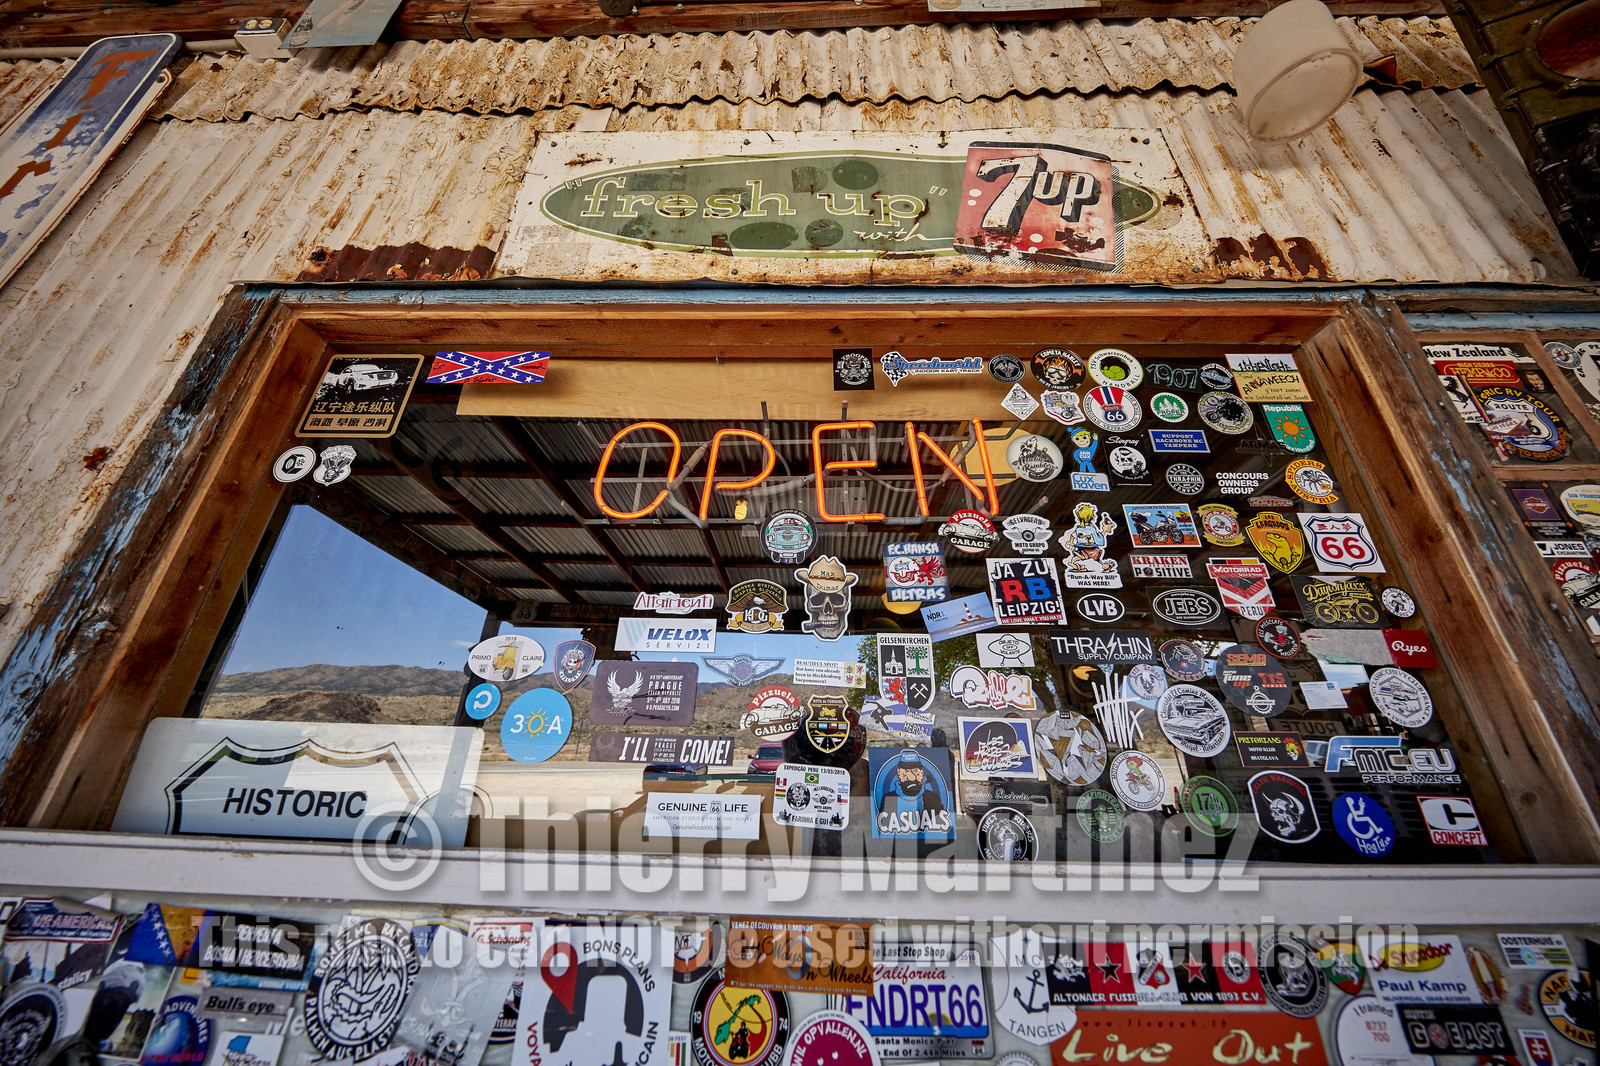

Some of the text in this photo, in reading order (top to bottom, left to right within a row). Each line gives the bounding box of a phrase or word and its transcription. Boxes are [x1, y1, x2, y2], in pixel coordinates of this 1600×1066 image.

[1424, 346, 1508, 358] New Zealand
[885, 358, 982, 371] Speedworld
[1102, 374, 1141, 391] HANDBALL
[1146, 363, 1199, 389] 1907
[313, 401, 396, 413] 辽宁途乐纵队
[1263, 404, 1303, 412] Republik
[1107, 412, 1125, 421] 66
[1105, 436, 1140, 446] Stingray
[594, 416, 999, 523] OPEN
[1216, 472, 1269, 480] CONCOURS
[1286, 459, 1323, 482] SPIDERS
[1073, 482, 1109, 490] haven
[1291, 482, 1337, 504] AUSTRIA
[952, 511, 991, 530] Pizzuela
[950, 537, 991, 550] GARAGE
[1320, 537, 1367, 560] 66
[1131, 556, 1188, 565] KRAKEN
[991, 558, 1050, 580] JA ZU
[1554, 562, 1590, 581] Pizzuela
[890, 588, 946, 602] ULTRAS
[1000, 577, 1052, 603] RB
[999, 600, 1061, 618] LEIPZIG!
[1083, 599, 1117, 611] LVB
[1164, 598, 1213, 616] JEBS
[1240, 606, 1264, 616] PERU
[1010, 616, 1023, 624] LOVE
[648, 628, 713, 641] VELOX
[880, 637, 930, 645] GELSENKIRCHEN
[1114, 653, 1153, 661] COMPANY
[1226, 654, 1267, 664] SEMA
[648, 681, 683, 690] PRAGUE
[752, 690, 796, 706] Pizzuela
[754, 722, 799, 738] GARAGE
[680, 738, 732, 765] COME!
[784, 764, 807, 772] EXPEDIÇÃO
[1362, 774, 1462, 784] PERFORMANCE
[222, 788, 368, 818] HISTORIC
[658, 802, 750, 812] GENUINE LIFE
[792, 814, 815, 824] FARINHA
[878, 809, 952, 833] CASUALS
[672, 824, 732, 832] GenuineRoute66Life.com
[1432, 832, 1484, 844] CONCEPT
[732, 920, 750, 929] VENEZ
[750, 921, 783, 931] DÉCOUVRIR
[792, 924, 814, 932] MONDE
[882, 946, 945, 958] Last Stop Shop
[583, 940, 656, 992] BONS PLANS
[818, 957, 872, 984] Wheels
[872, 964, 948, 986] California
[1377, 980, 1468, 994] Paul Kamp
[1053, 992, 1106, 1002] ALTONAER
[1191, 992, 1214, 1002] VON
[1215, 992, 1240, 1002] 1893
[249, 999, 276, 1015] eye
[1358, 1003, 1394, 1018] trained
[1009, 1018, 1068, 1038] TANGEN
[874, 1038, 934, 1046] Santa Monica
[1372, 1032, 1390, 1042] 700
[884, 1049, 900, 1057] End
[1062, 1028, 1314, 1065] Live Out
